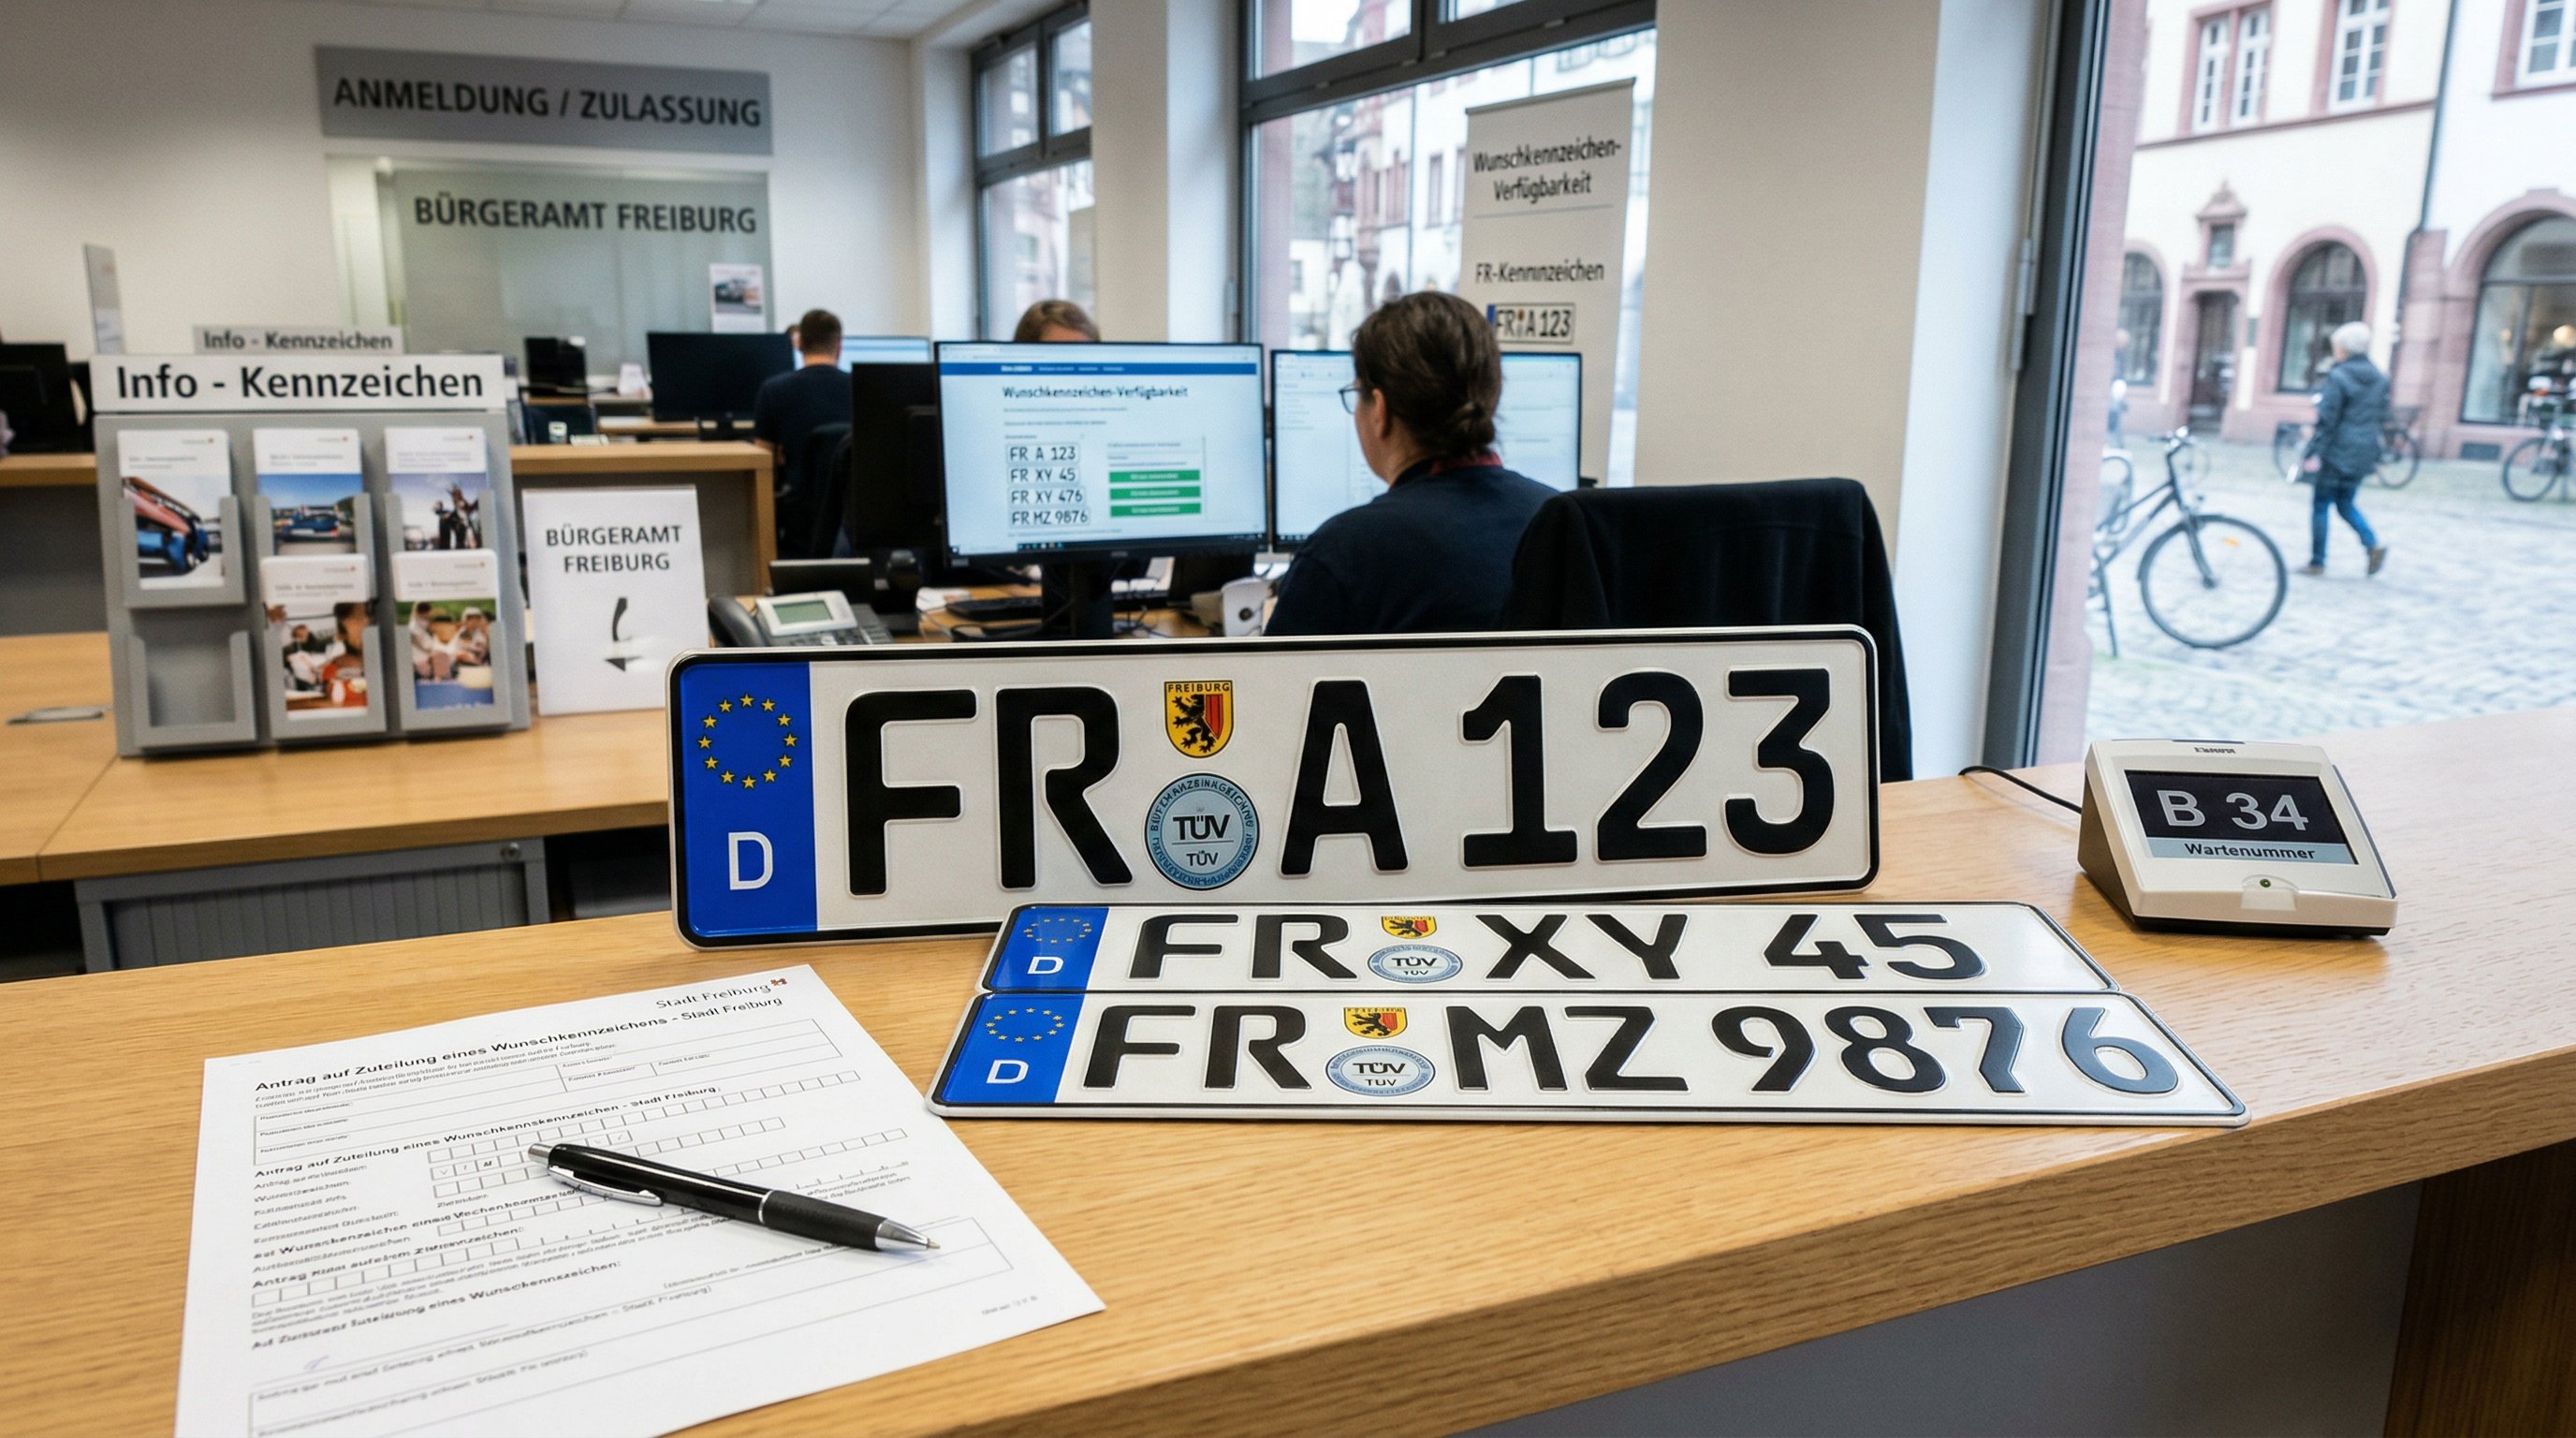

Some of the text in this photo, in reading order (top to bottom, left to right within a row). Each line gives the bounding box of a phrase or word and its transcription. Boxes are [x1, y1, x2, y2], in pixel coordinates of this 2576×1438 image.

[334, 78, 761, 127] ANMELDUNG / ZULASSUNG
[1493, 169, 1592, 204] Verfügbarkeit
[415, 192, 757, 234] BÜRGERAMT FREIBURG
[1539, 310, 1572, 337] 123
[203, 330, 244, 349] Info
[264, 329, 393, 349] Kennzeichen
[117, 364, 198, 398] Info
[241, 364, 484, 398] Kennzeichen
[1010, 446, 1076, 461] FR A 123
[1011, 467, 1076, 482] FR XY 45
[1011, 489, 1084, 505] FR XY 476
[1012, 511, 1031, 525] FR
[1033, 510, 1052, 524] MZ
[546, 524, 683, 547] BÜRGERAMT
[564, 552, 670, 573] FREIBURG
[1167, 682, 1231, 694] FREIBURG
[845, 686, 1134, 896] FR
[1280, 679, 1410, 876] A
[1461, 668, 1836, 868] 123
[2157, 789, 2309, 831] B 34
[1173, 814, 1231, 841] TÜV
[727, 832, 774, 891] D
[1186, 850, 1219, 866] TÜV
[2184, 842, 2316, 860] Wartenummer
[1128, 914, 1987, 980] FR XY 45
[1028, 956, 1064, 975] D
[1391, 956, 1439, 967] TÜV
[655, 982, 772, 1009] Stadt Freiburg
[255, 1071, 316, 1091] Antrag
[323, 1067, 350, 1080] auf
[355, 1054, 437, 1076] Zuteilung
[442, 1047, 487, 1061] eines
[681, 1008, 720, 1021] Stadt
[723, 997, 783, 1014] Freiburg
[1083, 1005, 2181, 1094] FR MZ 9876
[986, 1060, 1029, 1084] D
[1353, 1063, 1407, 1074] TÜV
[255, 1163, 303, 1178] Antrag
[307, 1157, 330, 1168] auf
[332, 1146, 400, 1164] Zuteilung
